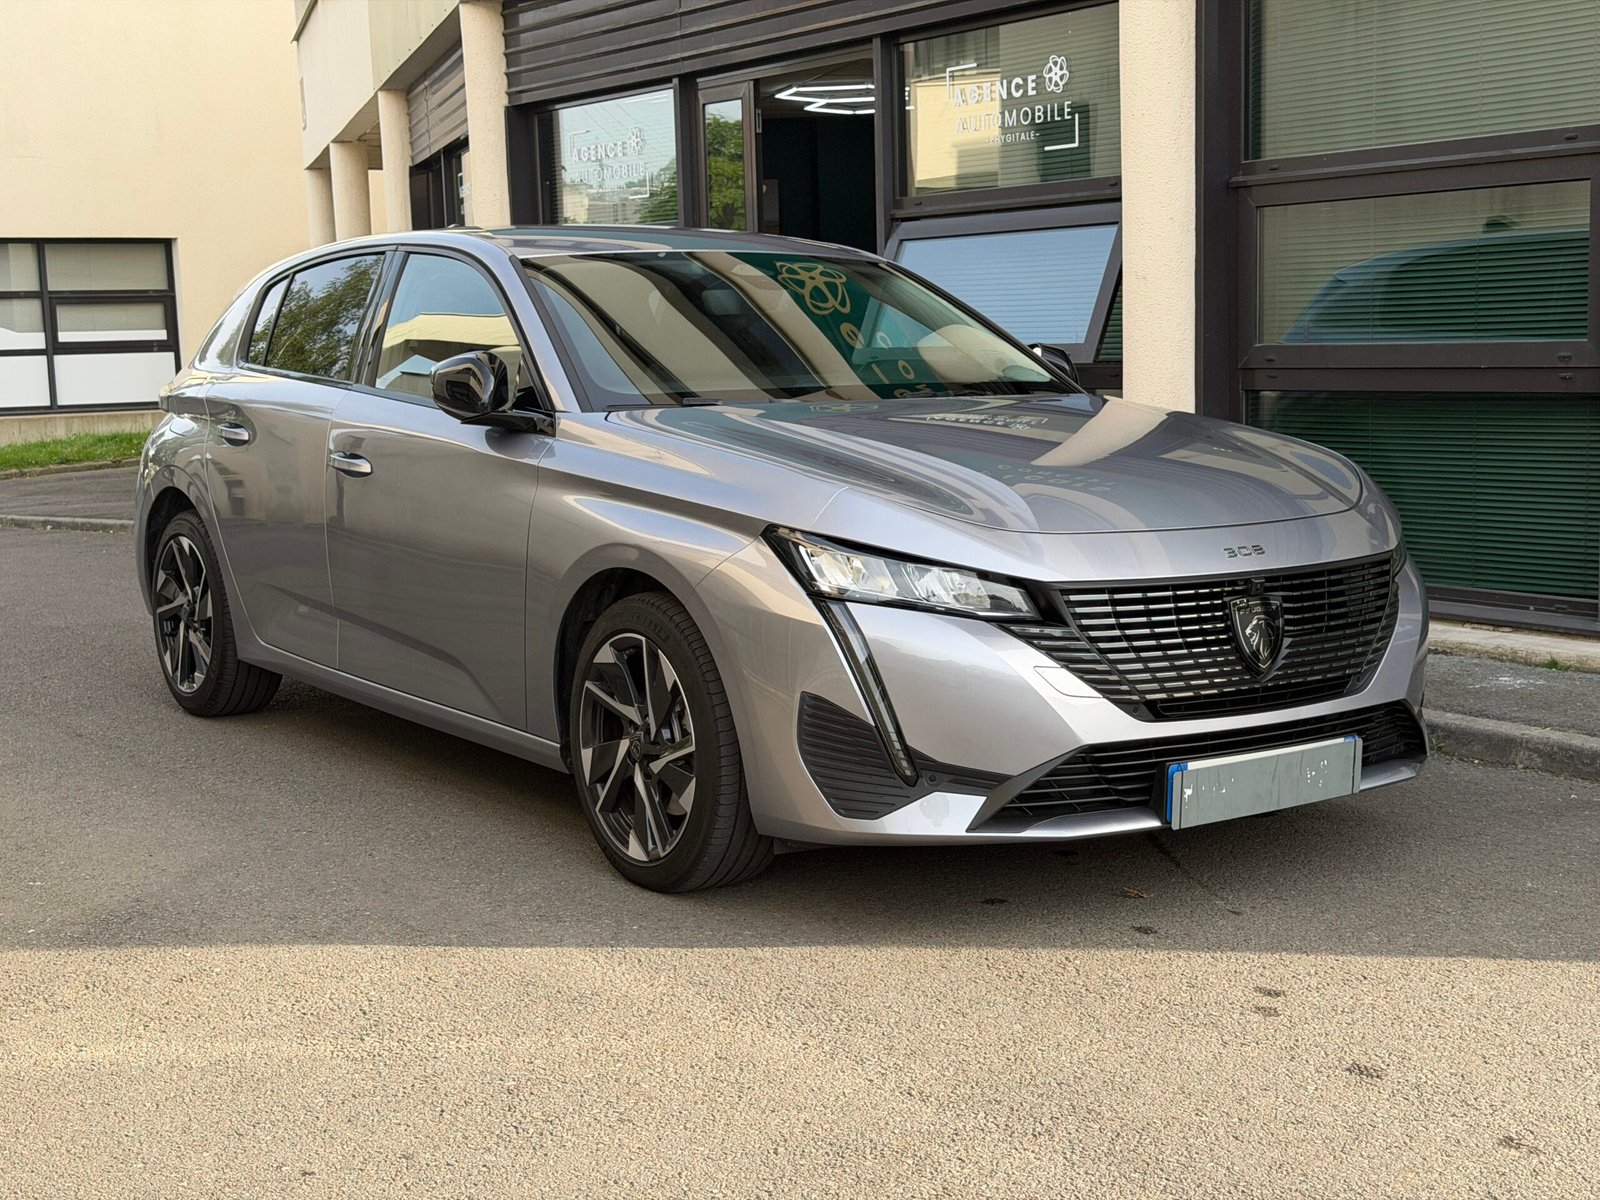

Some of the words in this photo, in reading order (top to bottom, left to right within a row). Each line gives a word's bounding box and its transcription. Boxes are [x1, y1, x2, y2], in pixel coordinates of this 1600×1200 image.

[953, 74, 1037, 107] AGENCE
[956, 100, 1073, 135] AUTOMOBILE
[573, 141, 625, 163] AGENCE
[1223, 544, 1266, 559] 308
